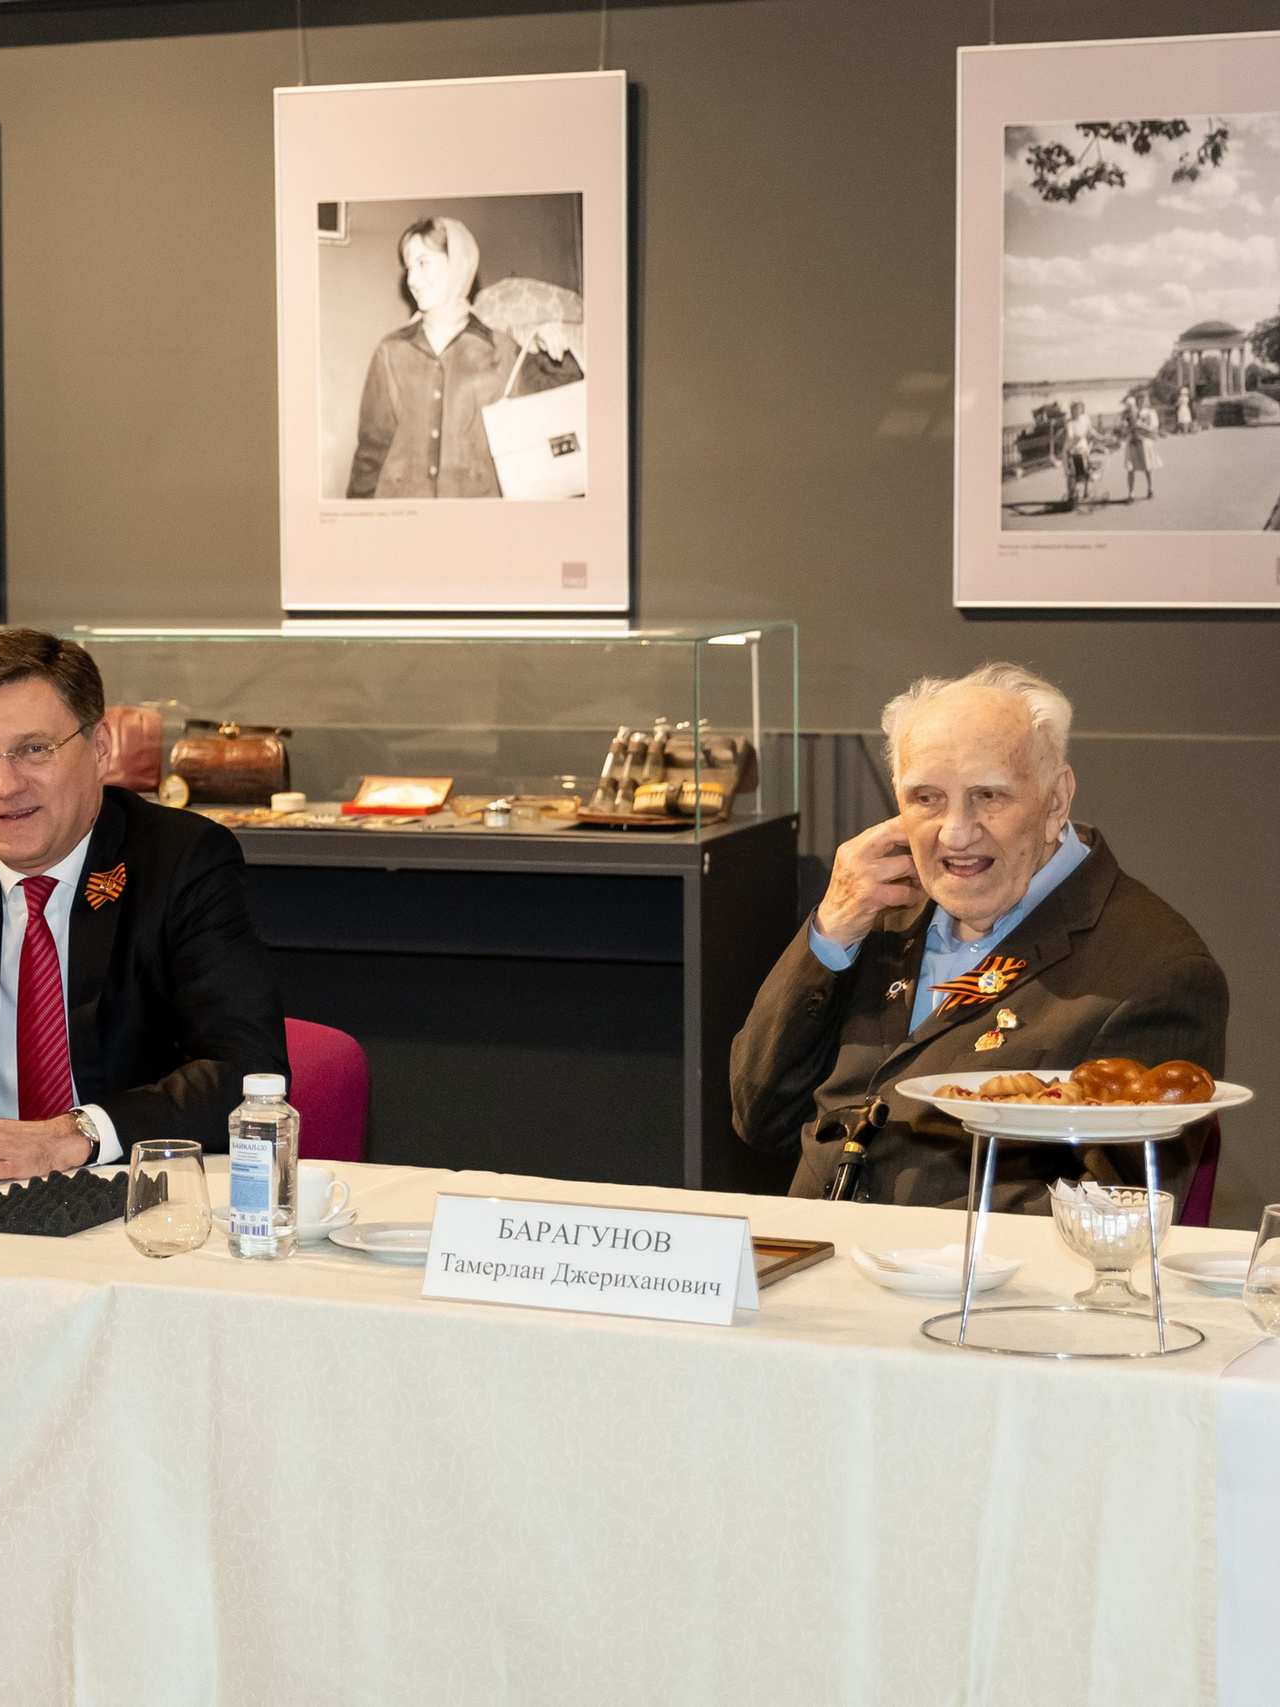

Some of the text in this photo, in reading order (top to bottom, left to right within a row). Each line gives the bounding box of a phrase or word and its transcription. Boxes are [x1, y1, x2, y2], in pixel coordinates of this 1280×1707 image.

[497, 1218, 672, 1253] БАРАГУНОВ
[441, 1252, 722, 1297] Тамерлан Джериханович
